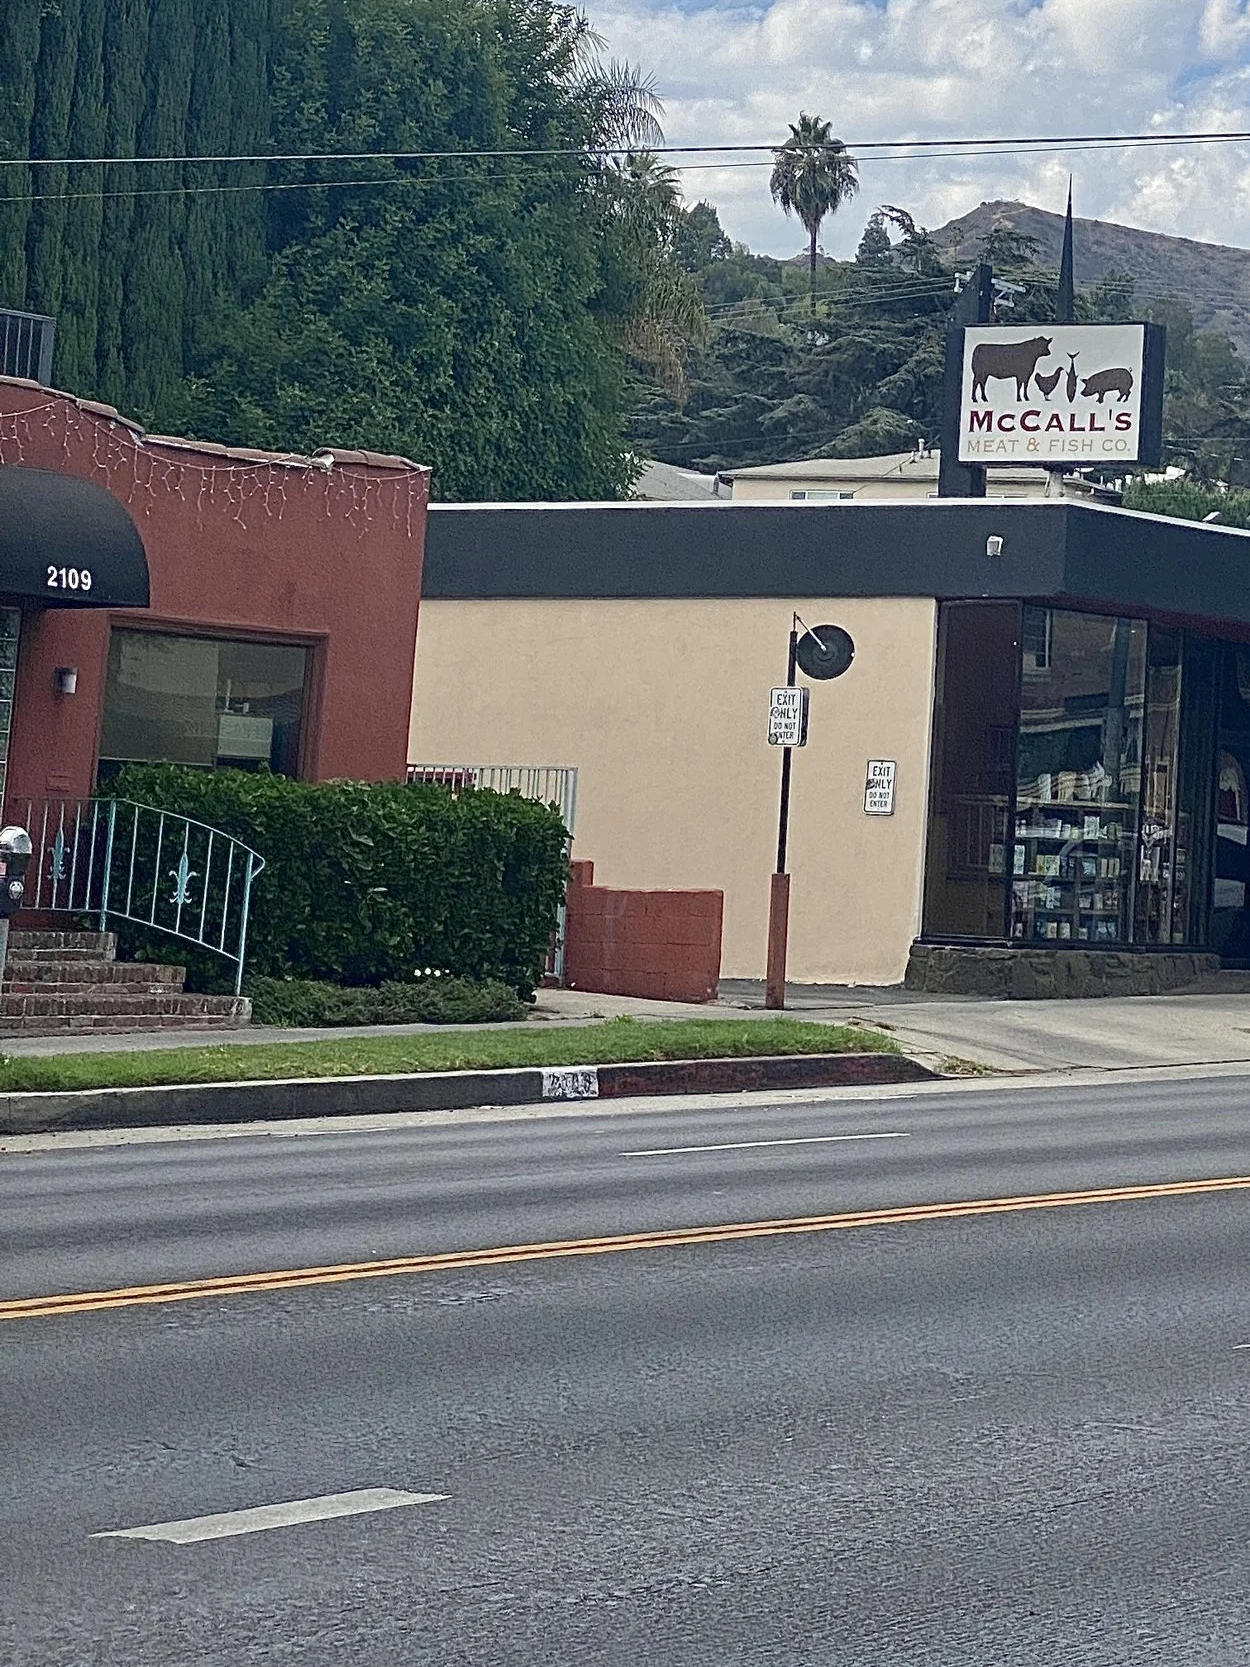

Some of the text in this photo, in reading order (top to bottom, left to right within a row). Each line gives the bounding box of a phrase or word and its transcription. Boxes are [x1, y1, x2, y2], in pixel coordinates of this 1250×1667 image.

[969, 409, 1132, 433] McCALL'S
[967, 437, 1131, 453] MEAT & FISH CO.
[47, 565, 92, 591] 2109
[777, 694, 796, 705] EXIT
[774, 722, 796, 730] DO NOT
[873, 766, 891, 777] EXIT
[869, 791, 877, 799] DO
[870, 800, 888, 808] ENTER
